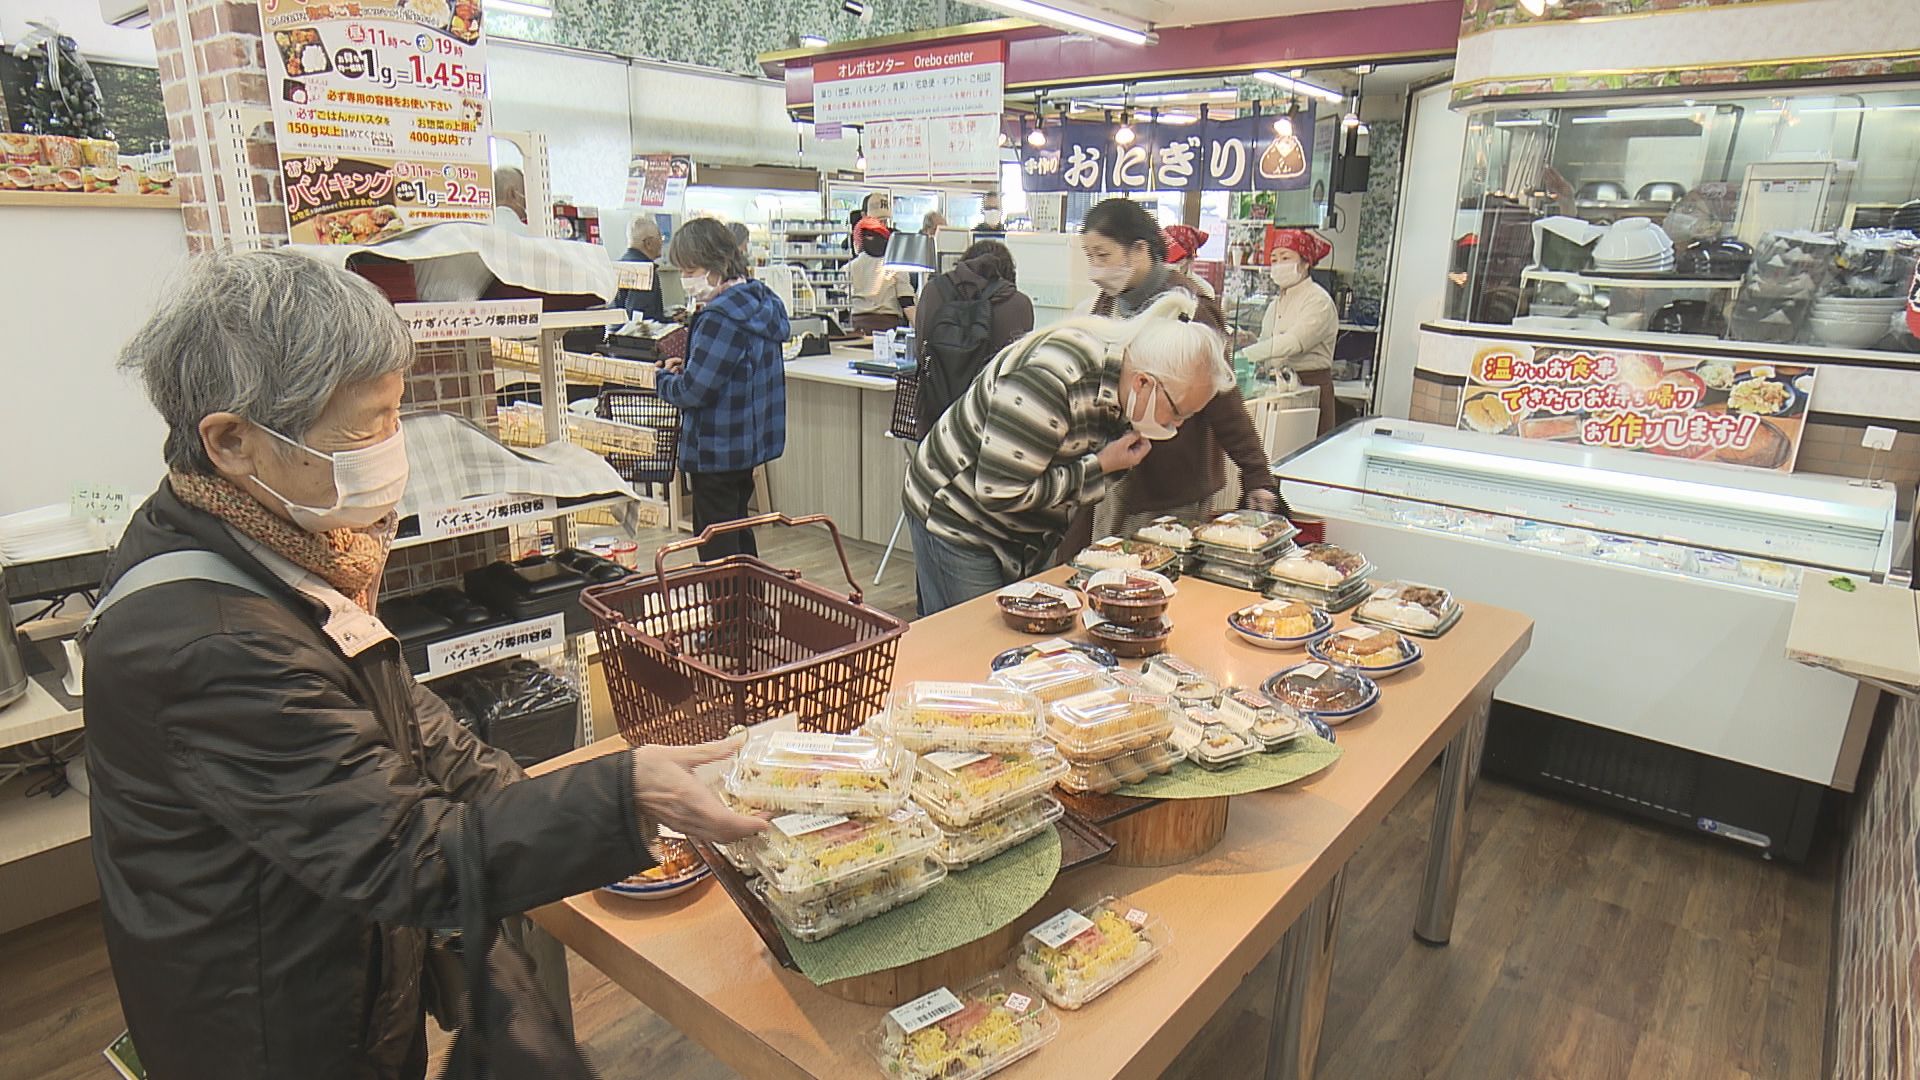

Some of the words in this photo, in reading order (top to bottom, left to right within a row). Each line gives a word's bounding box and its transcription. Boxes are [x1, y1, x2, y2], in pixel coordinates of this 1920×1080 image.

[838, 60, 905, 78] オレボセンター
[914, 53, 942, 68] Orebo
[944, 51, 974, 65] center
[327, 89, 453, 112] 必ず専用の容器をお使い下さい
[418, 117, 477, 132] お惣菜の上限は
[410, 131, 472, 146] 400g以内です
[285, 156, 338, 178] おかず
[1024, 157, 1058, 175] 手作り
[1064, 136, 1246, 188] おにぎり
[288, 170, 393, 213] バイキング
[1484, 354, 1617, 381] 温かいお食事
[1501, 383, 1698, 411] できたてお持ち帰り
[1584, 411, 1760, 447] お作りします!
[79, 490, 123, 501] ごはん用
[86, 501, 120, 511] パック
[436, 498, 544, 528] バイキング専用容器
[444, 627, 552, 664] バイキング専用容器
